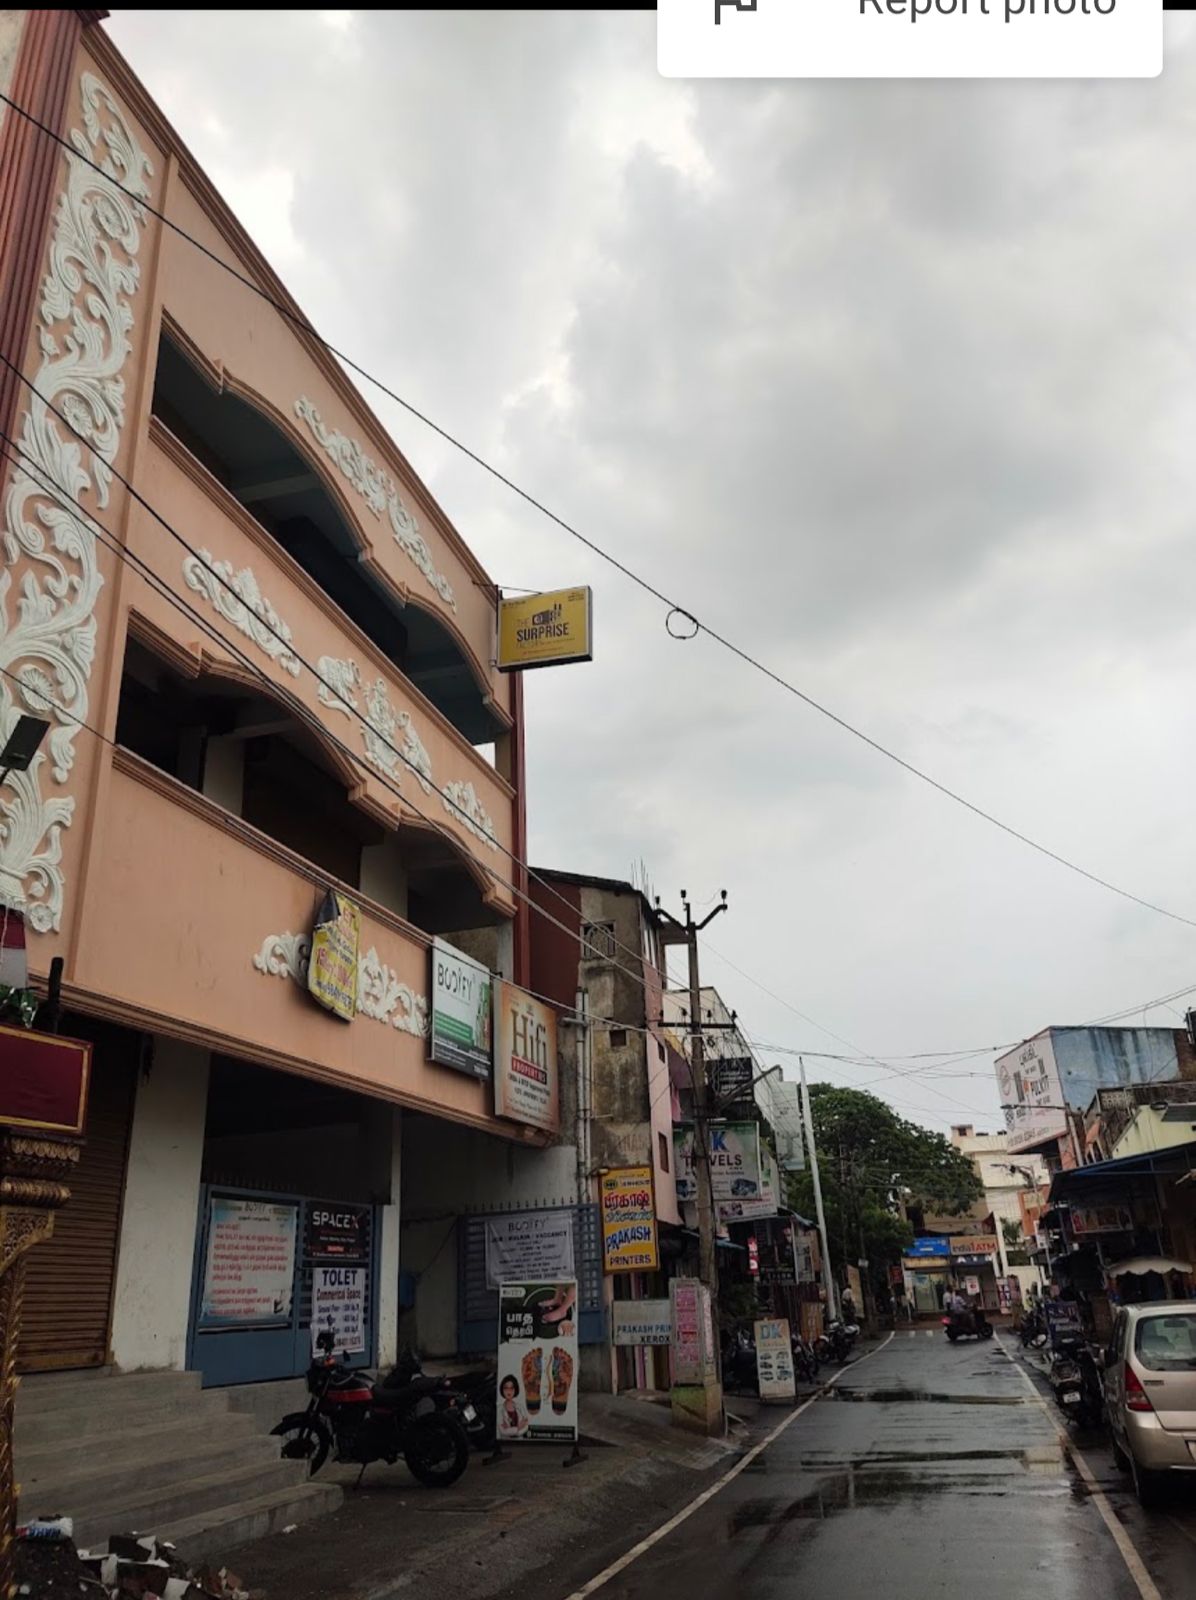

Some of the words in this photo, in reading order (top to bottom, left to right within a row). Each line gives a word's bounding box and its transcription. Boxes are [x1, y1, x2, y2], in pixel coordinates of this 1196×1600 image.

[516, 622, 569, 642] SURPRISE
[511, 1008, 548, 1070] Hifi
[312, 1210, 360, 1229] SPACEX
[605, 1226, 651, 1254] PRAKASH
[610, 1254, 651, 1266] PRINTERS
[322, 1270, 358, 1286] TOLET
[617, 1324, 653, 1333] PRAKASH
[640, 1335, 670, 1344] XEROX
